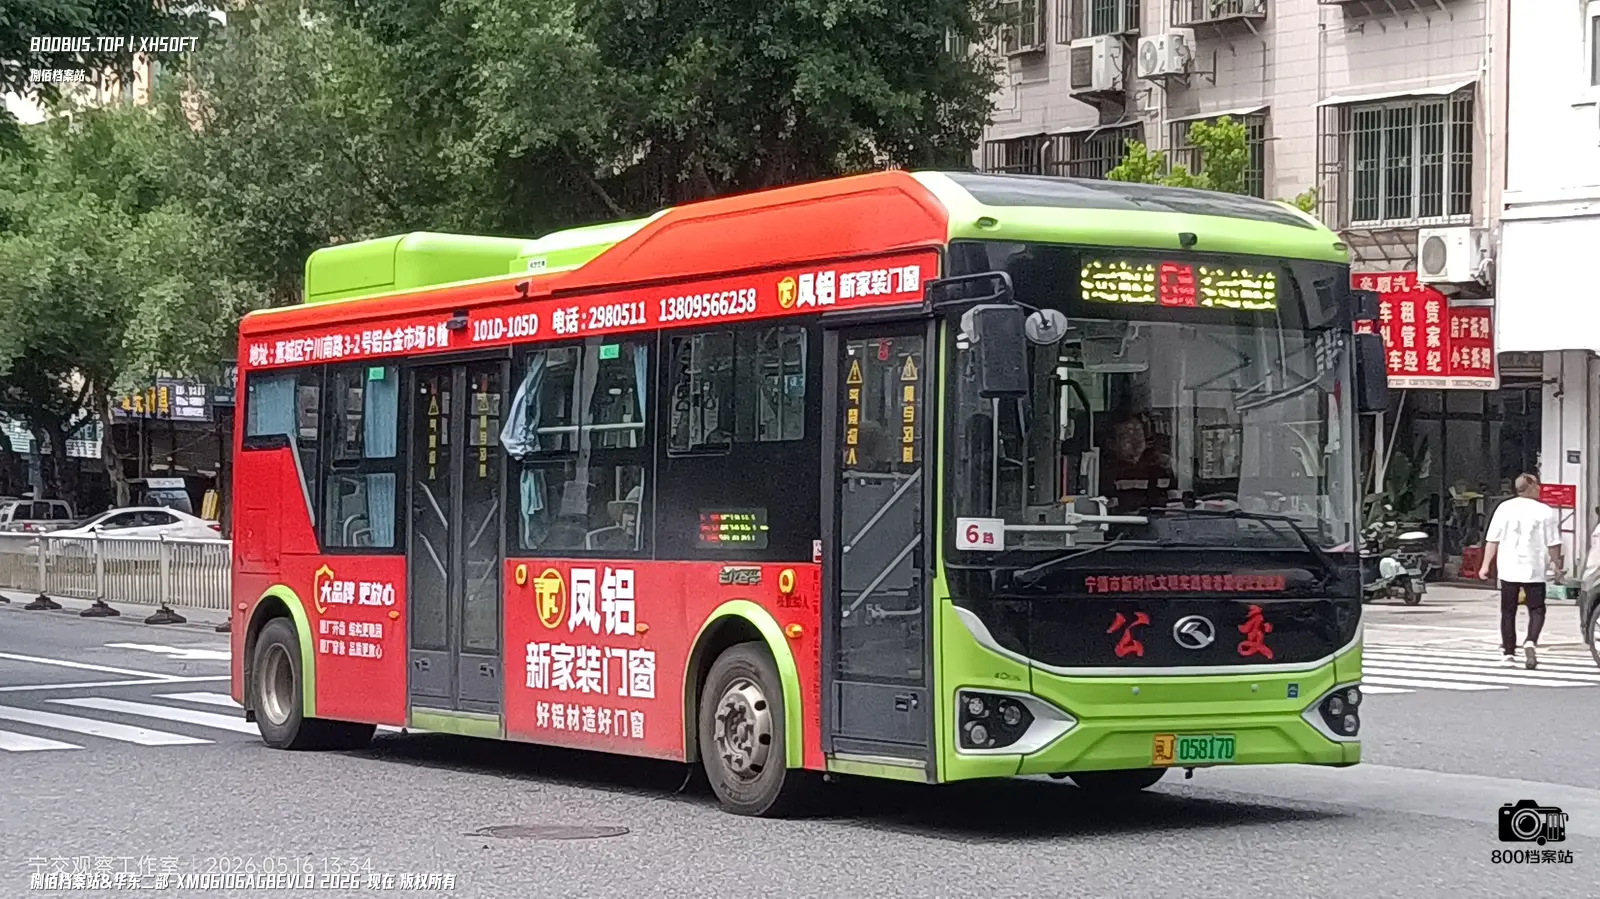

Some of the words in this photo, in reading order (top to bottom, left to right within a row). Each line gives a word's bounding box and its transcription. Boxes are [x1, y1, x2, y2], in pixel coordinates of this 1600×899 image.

[473, 313, 539, 342] 101D-105D
[659, 288, 757, 322] 13809566258
[839, 265, 920, 300] 新家装门窗
[567, 566, 636, 636] 凤铝
[1106, 611, 1150, 658] 公
[526, 642, 656, 699] 新家装门窗
[536, 701, 645, 739] 好铝材造好门窗
